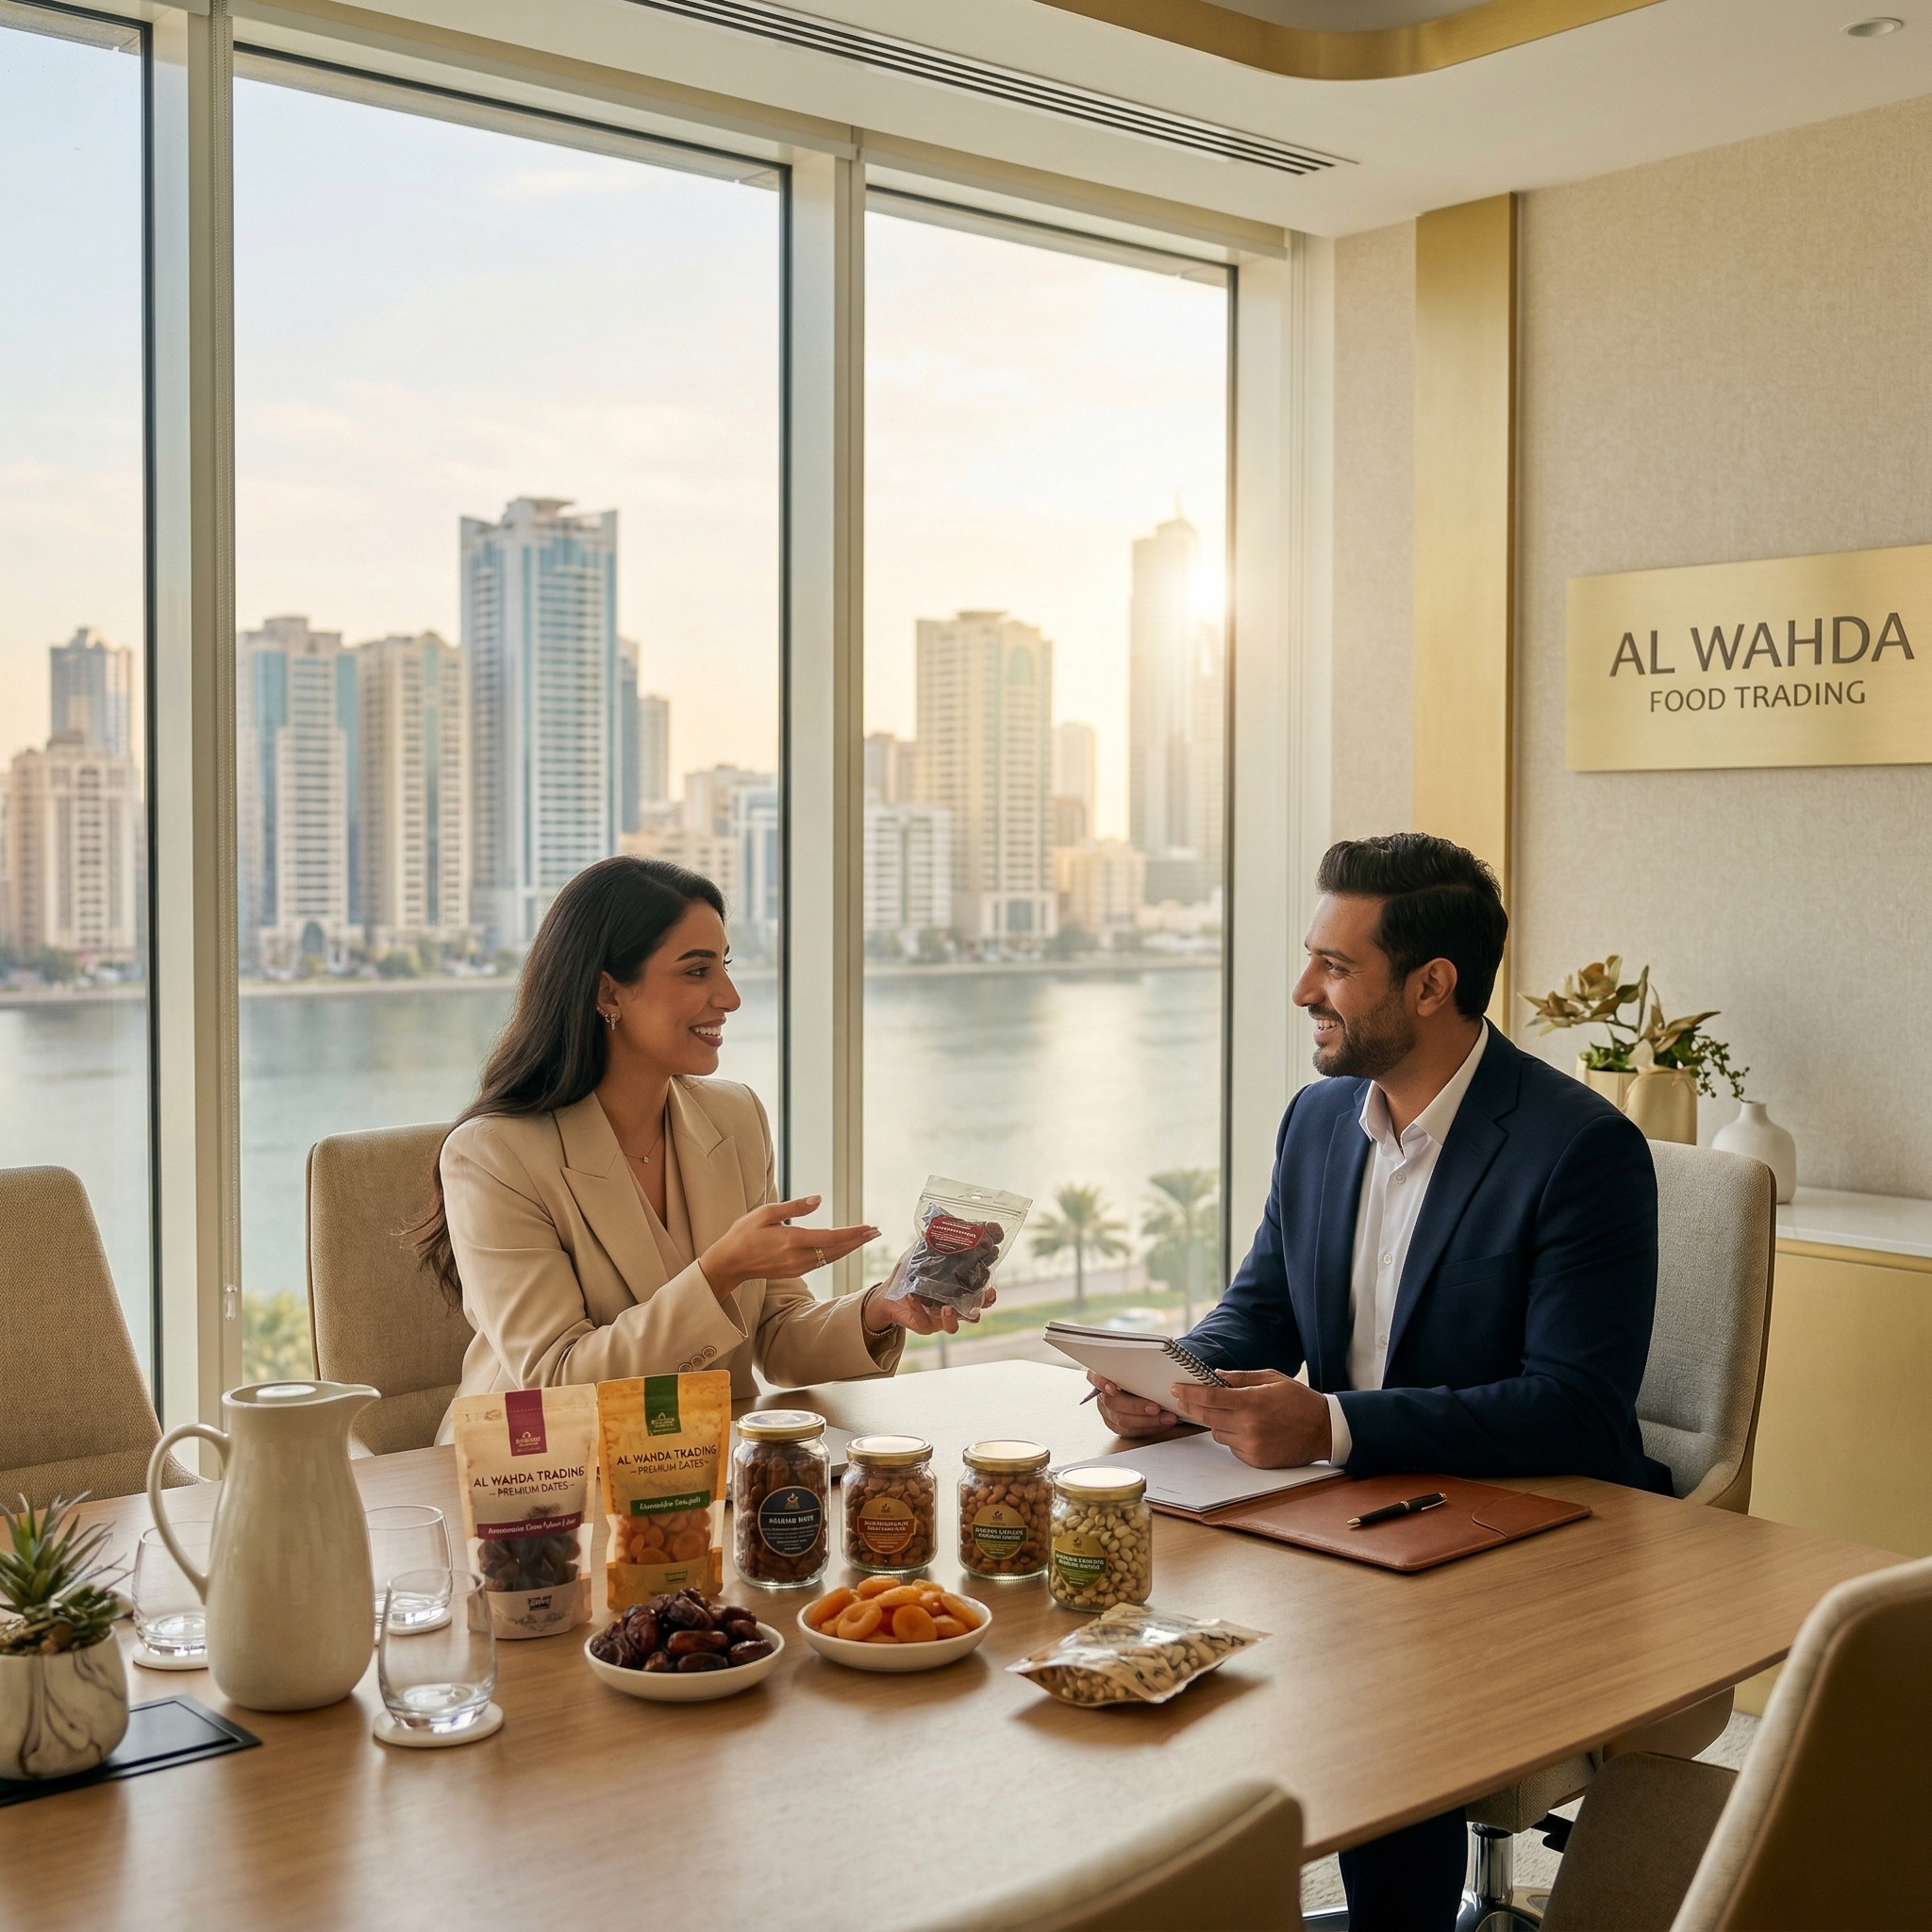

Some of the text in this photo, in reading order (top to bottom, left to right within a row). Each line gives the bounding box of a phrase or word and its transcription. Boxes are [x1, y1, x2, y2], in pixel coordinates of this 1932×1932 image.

[1609, 612, 1915, 677] AL WAHDA
[1650, 680, 1866, 712] FOOD TRADING
[616, 1456, 631, 1465] AL
[474, 1466, 585, 1488] AL WAHDA TRADING
[497, 1481, 569, 1497] PREMIUM DATES
